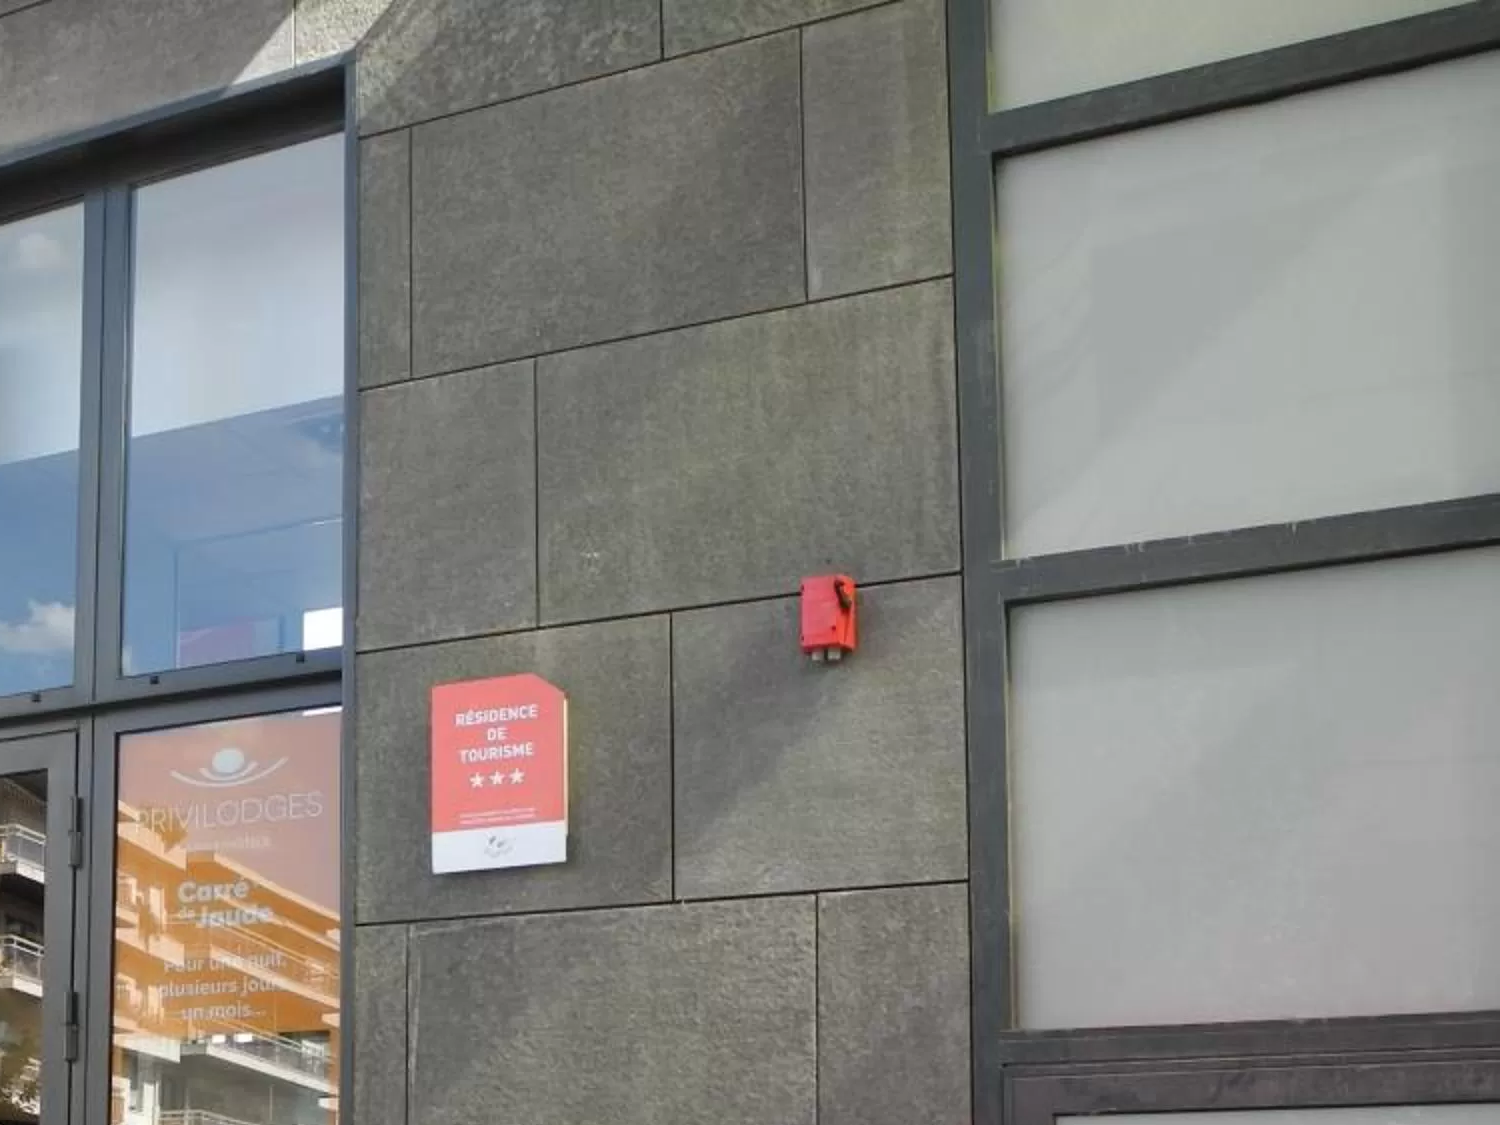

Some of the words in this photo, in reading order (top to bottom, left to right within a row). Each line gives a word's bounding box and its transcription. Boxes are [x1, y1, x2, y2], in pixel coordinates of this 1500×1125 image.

[455, 704, 539, 726] RÉSIDENCE
[487, 727, 508, 741] DE
[460, 742, 534, 764] TOURISME
[135, 790, 324, 833] PRIVILODGES
